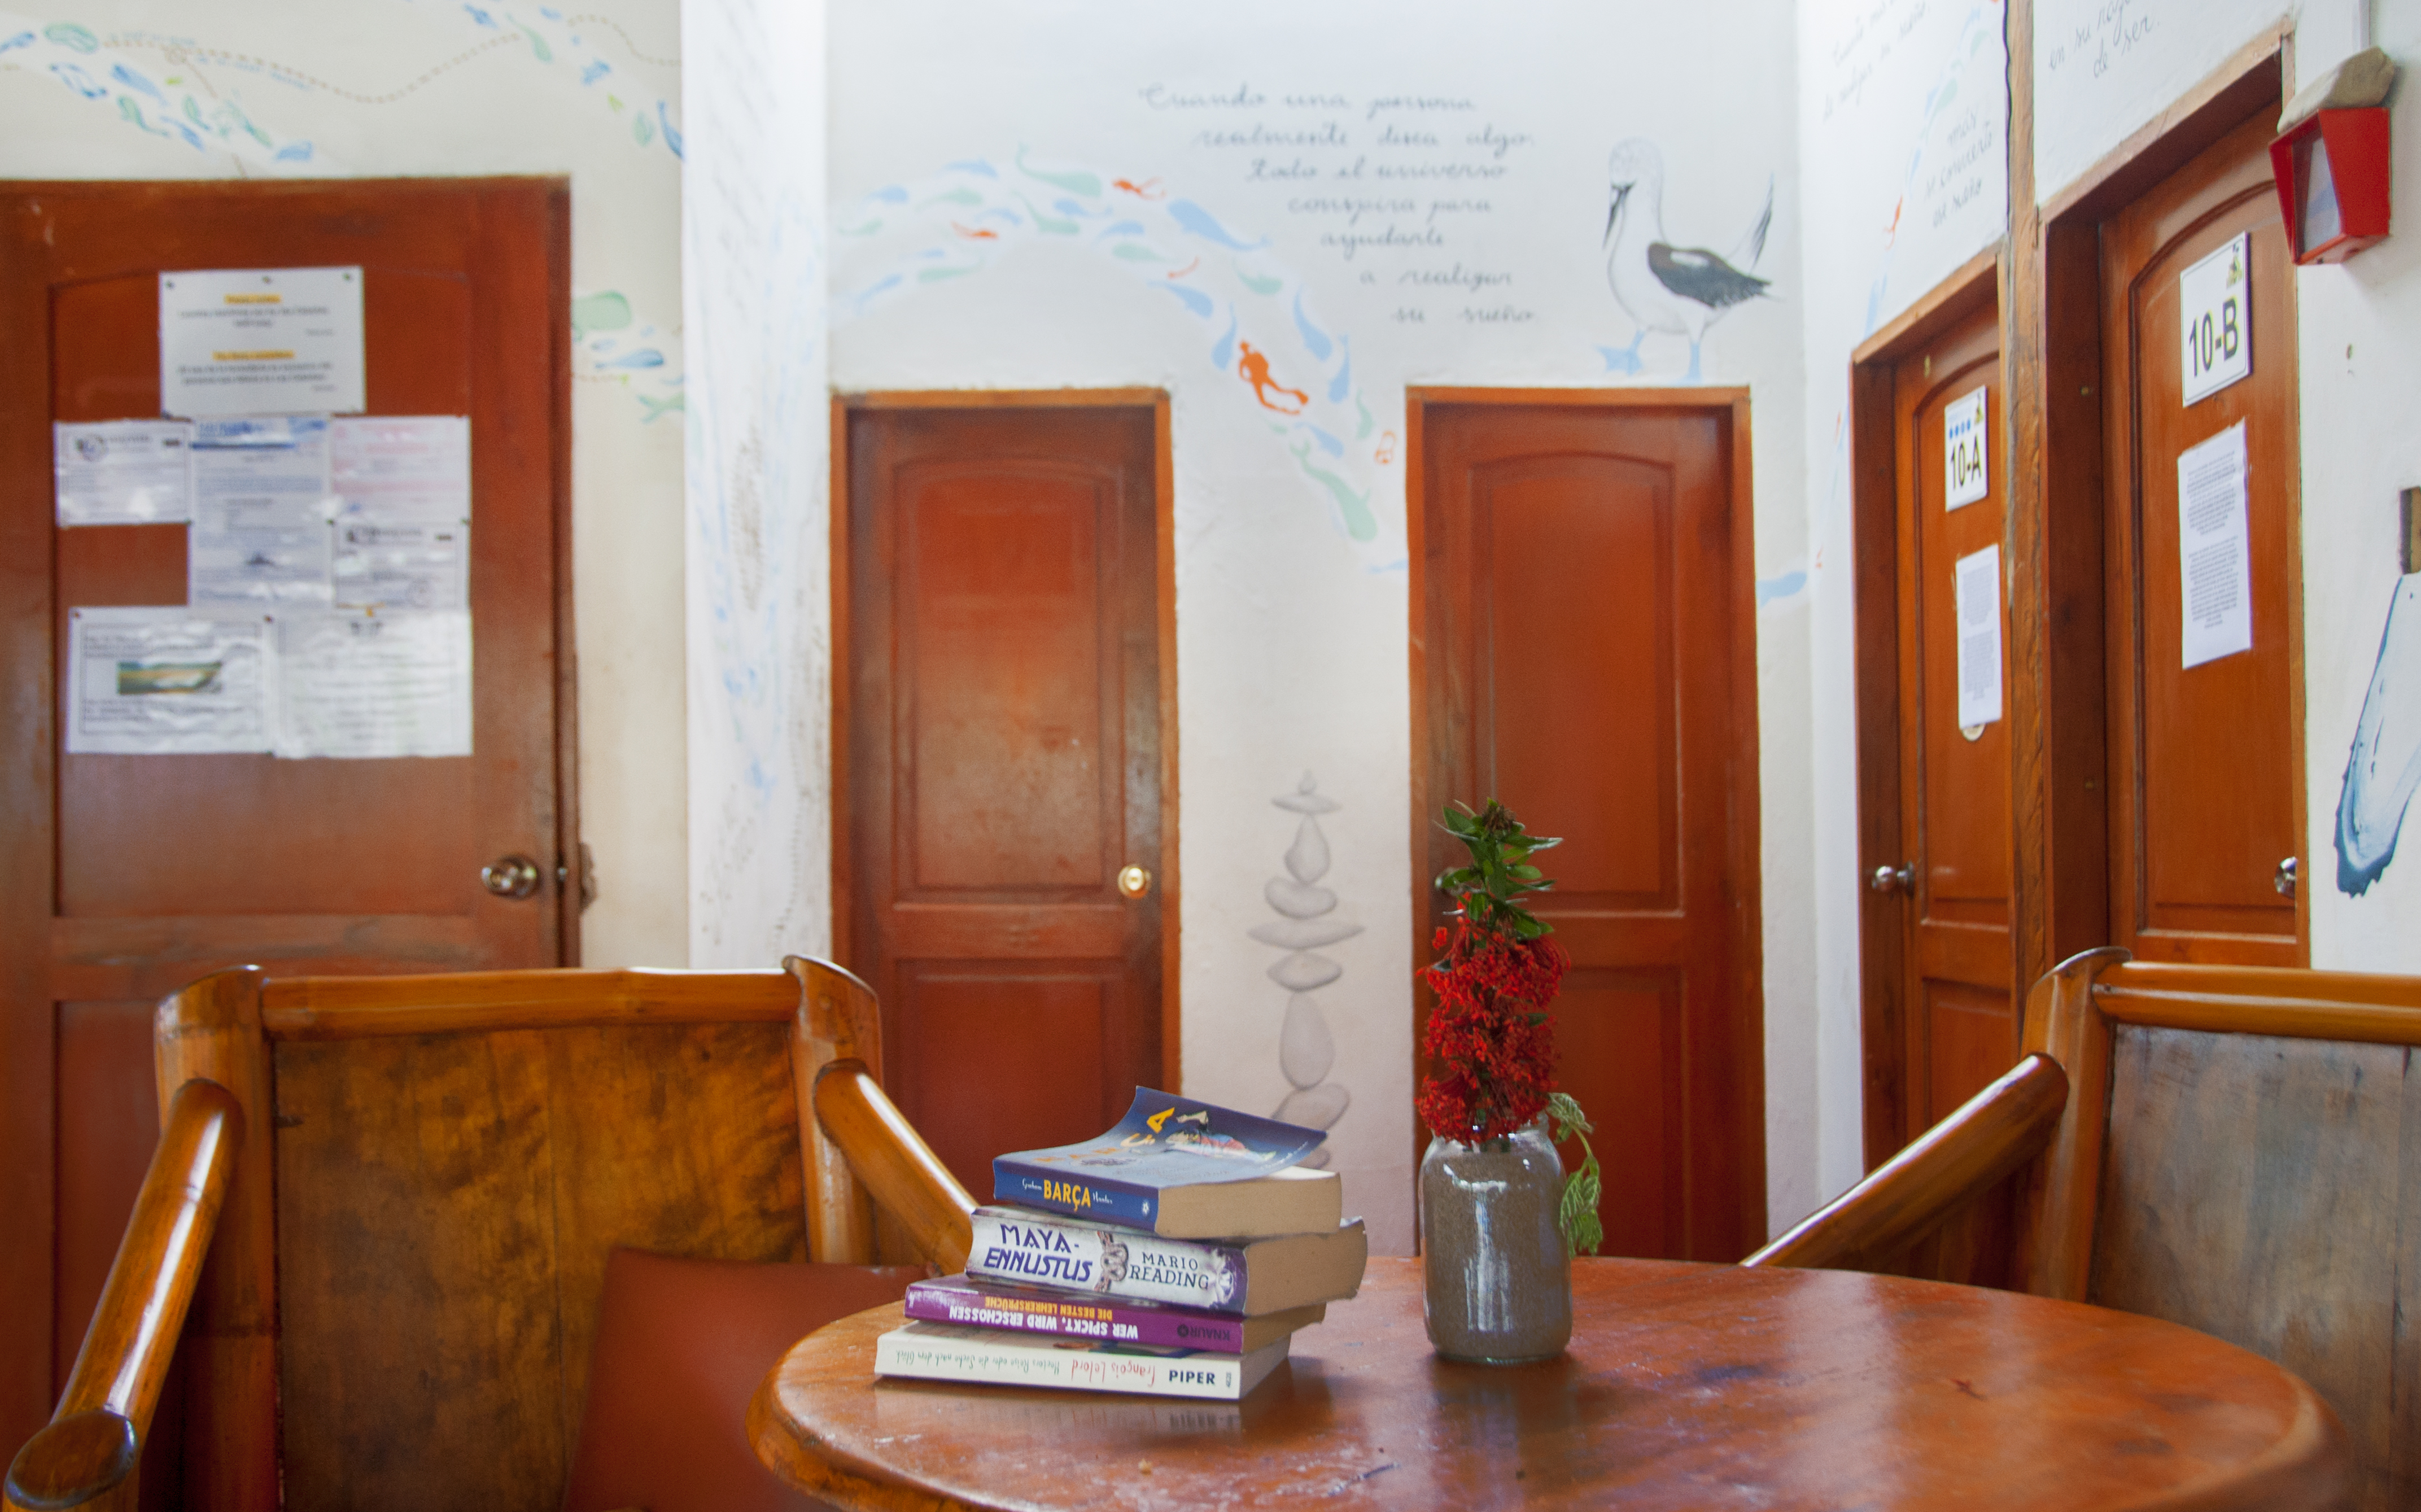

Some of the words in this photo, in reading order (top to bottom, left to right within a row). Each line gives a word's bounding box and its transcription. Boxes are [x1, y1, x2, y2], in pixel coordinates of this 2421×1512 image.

[2048, 46, 2065, 71] en
[2074, 23, 2091, 54] su
[2094, 37, 2108, 78] de
[2121, 15, 2160, 56] ser.
[1138, 81, 1268, 111] Cuando
[1283, 93, 1352, 110] una
[1366, 95, 1476, 121] persona
[1190, 122, 1348, 148] realmente
[1244, 157, 1318, 183] todo
[1334, 154, 1365, 180] el
[1377, 160, 1508, 181] universo
[1288, 197, 1416, 226] conspira
[1425, 198, 1492, 224] para
[1320, 222, 1443, 261] ayudarte
[1359, 269, 1376, 285] a
[1398, 261, 1513, 292] realizar
[1392, 305, 1425, 323] su
[2188, 296, 2239, 378] 10-B
[1950, 434, 1982, 491] 10-A
[1043, 1179, 1091, 1212] BARÇA
[1000, 1223, 1080, 1254] MAYA-
[984, 1247, 1093, 1282] ENNUSTUS
[1141, 1252, 1199, 1271] MARIO
[1129, 1265, 1209, 1290] READING
[949, 1305, 1024, 1327] ERSCHOSSEN
[985, 1296, 1057, 1316] LEHRERSPRÜCHE
[1059, 1304, 1094, 1319] BESTEN
[1097, 1309, 1113, 1321] DIE
[1026, 1312, 1057, 1331] WIRD
[1061, 1316, 1109, 1336] SPICKT,
[1113, 1322, 1139, 1339] WER
[1189, 1323, 1231, 1341] KNAUR
[895, 1348, 915, 1366] Glück
[917, 1350, 932, 1366] dem
[935, 1352, 952, 1366] nach
[955, 1354, 976, 1369] Suche
[978, 1355, 989, 1369] die
[992, 1357, 1008, 1370] oder
[1011, 1357, 1029, 1373] Reise
[1032, 1360, 1060, 1375] Hectors
[1070, 1358, 1105, 1383] Lelord
[1168, 1369, 1216, 1386] PIPER
